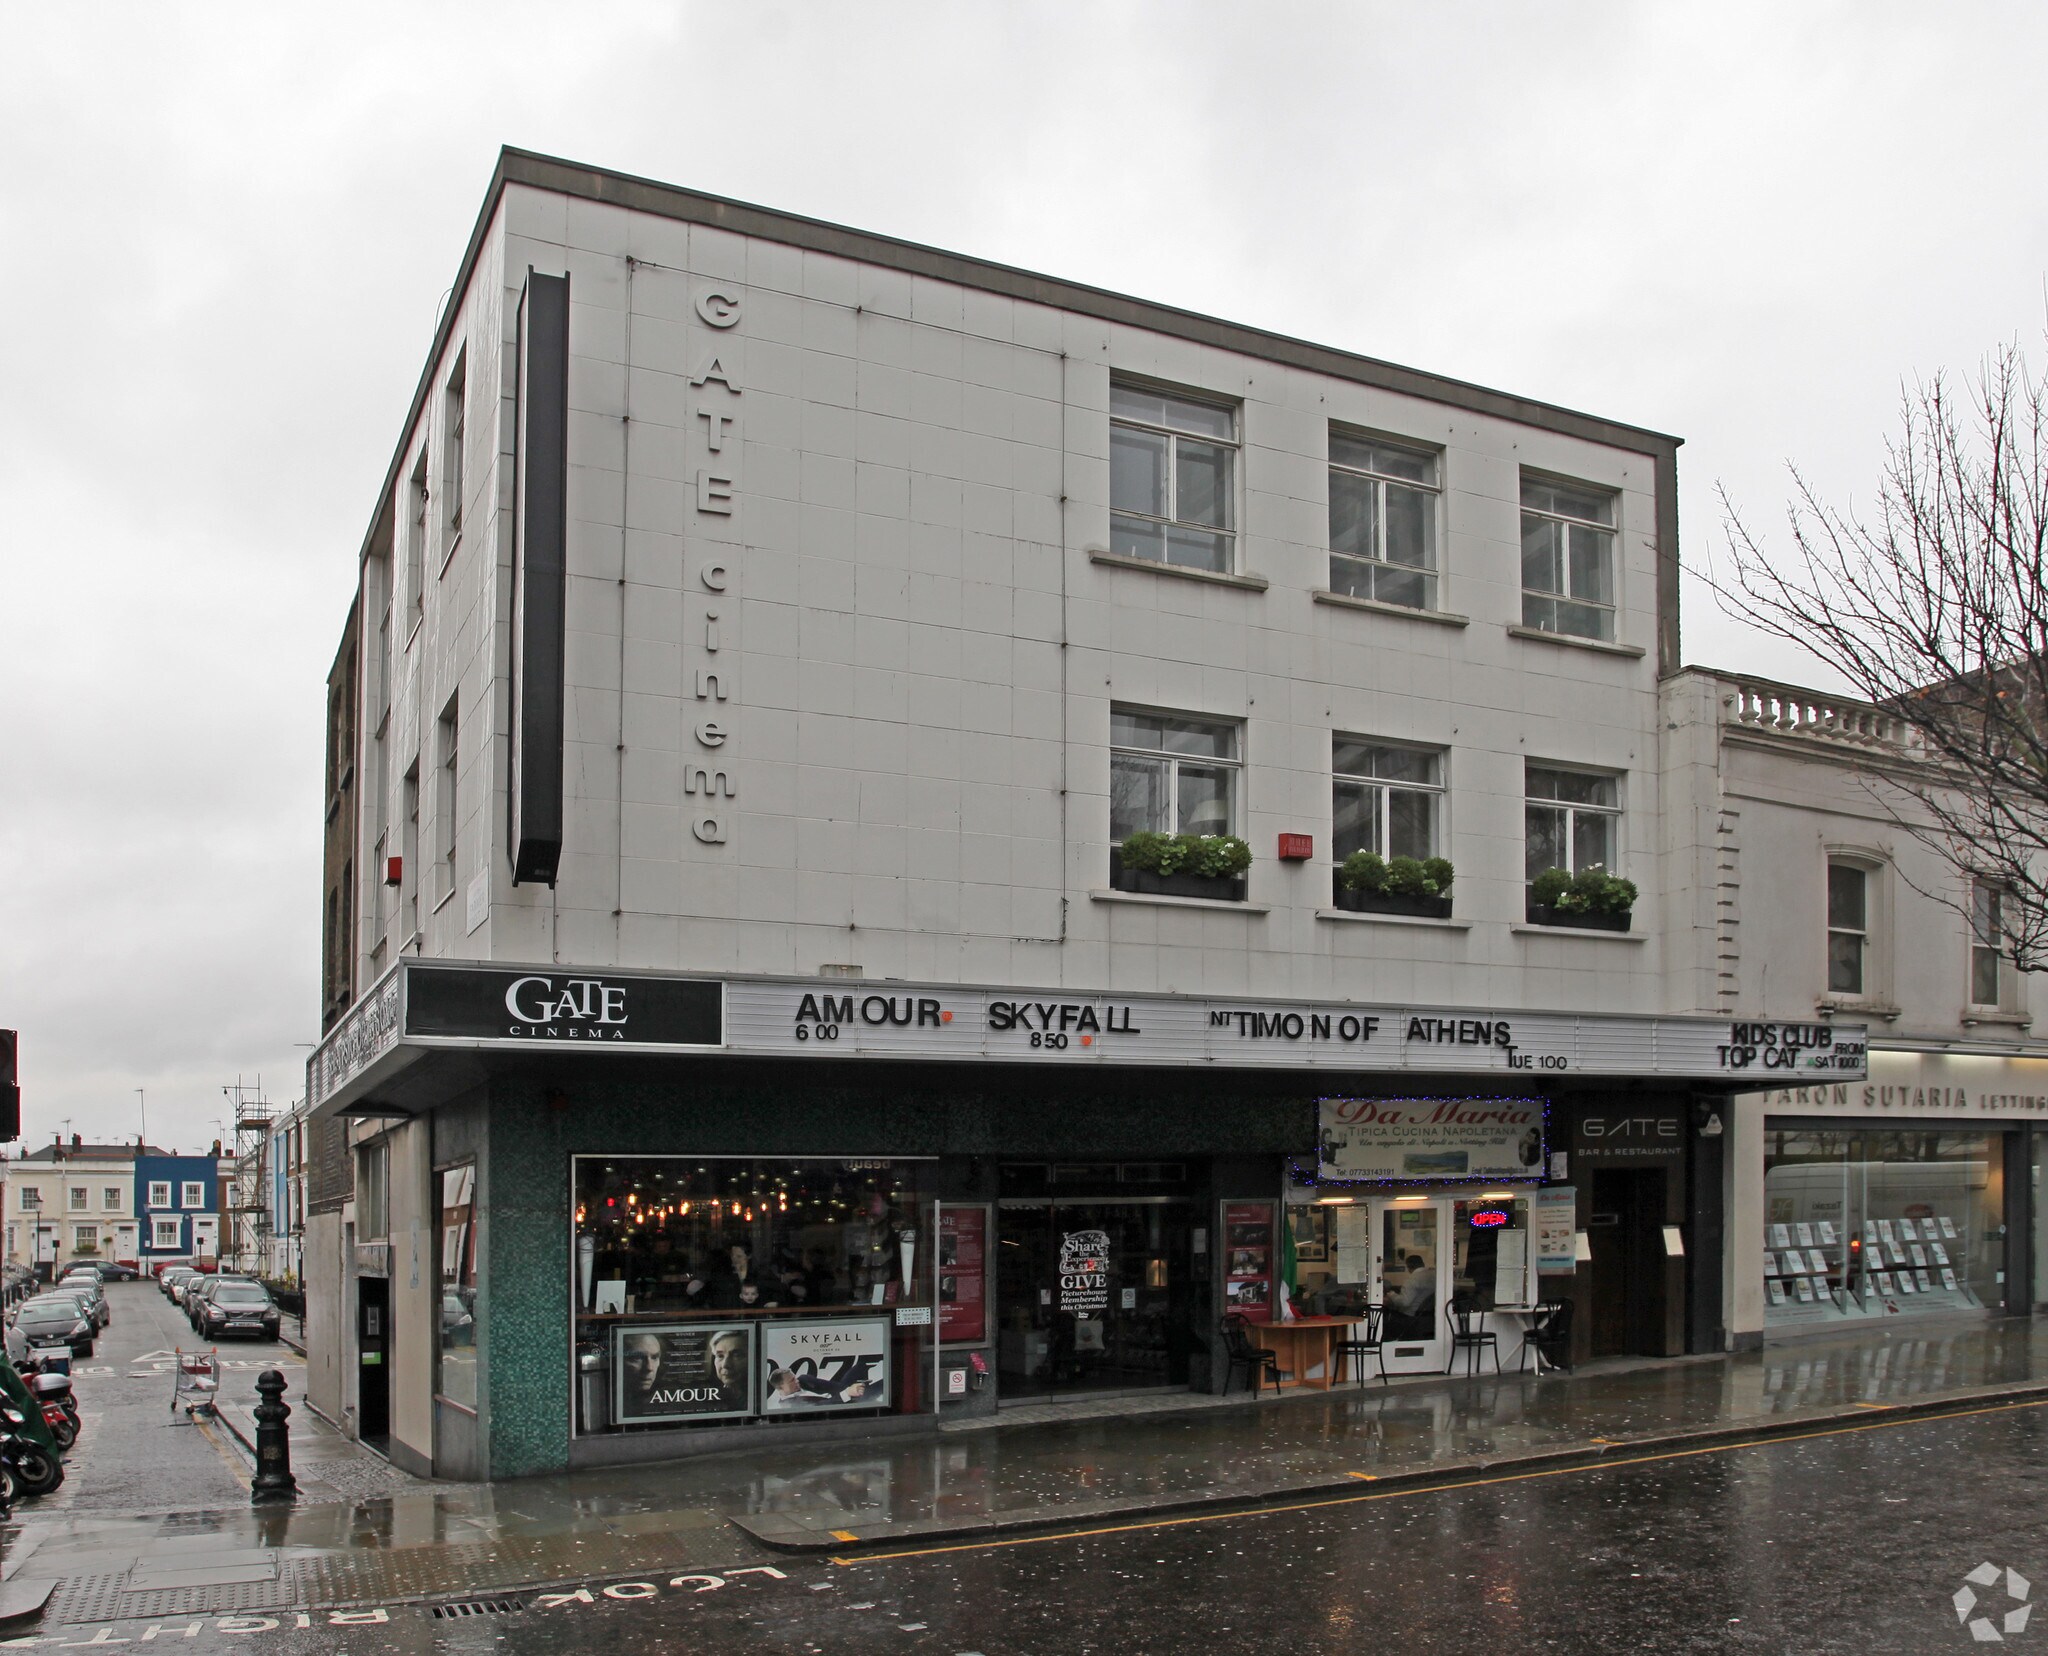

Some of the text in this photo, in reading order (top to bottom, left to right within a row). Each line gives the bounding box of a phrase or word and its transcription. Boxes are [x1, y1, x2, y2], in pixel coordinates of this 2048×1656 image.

[690, 286, 742, 517] GATE
[504, 976, 629, 1024] GATE
[795, 993, 942, 1028] AMOUR
[988, 1001, 1141, 1034] SKYFALL
[509, 1025, 624, 1039] CINEMA
[1211, 1010, 1233, 1027] NT
[1339, 1015, 1379, 1042] OF
[1406, 1016, 1511, 1046] ATHENS
[1731, 1023, 1833, 1048] KIDS CLUB
[1717, 1045, 1801, 1068] TOP CAT
[1834, 1043, 1865, 1055] FROM
[1815, 1055, 1838, 1069] SAT
[1863, 1085, 1969, 1108] SUTARIA
[1980, 1094, 2048, 1111] LETTING
[1334, 1100, 1533, 1126] Da Maria
[1348, 1126, 1517, 1137] TIPICA CUCINA NAPOLETANA
[1582, 1118, 1678, 1137] GATE
[1578, 1147, 1682, 1157] BAR & RESTAURANT
[1473, 1213, 1507, 1225] OPEN
[1065, 1238, 1104, 1252] Share
[1060, 1274, 1107, 1289] GIVE
[1060, 1289, 1108, 1298] Picturehouse
[1060, 1295, 1108, 1304] Membership
[1074, 1303, 1107, 1311] Christmas
[790, 1333, 862, 1345] SKYFALL
[649, 1387, 721, 1404] AMOUR
[58, 1566, 789, 1647] LOOK RIGHT
